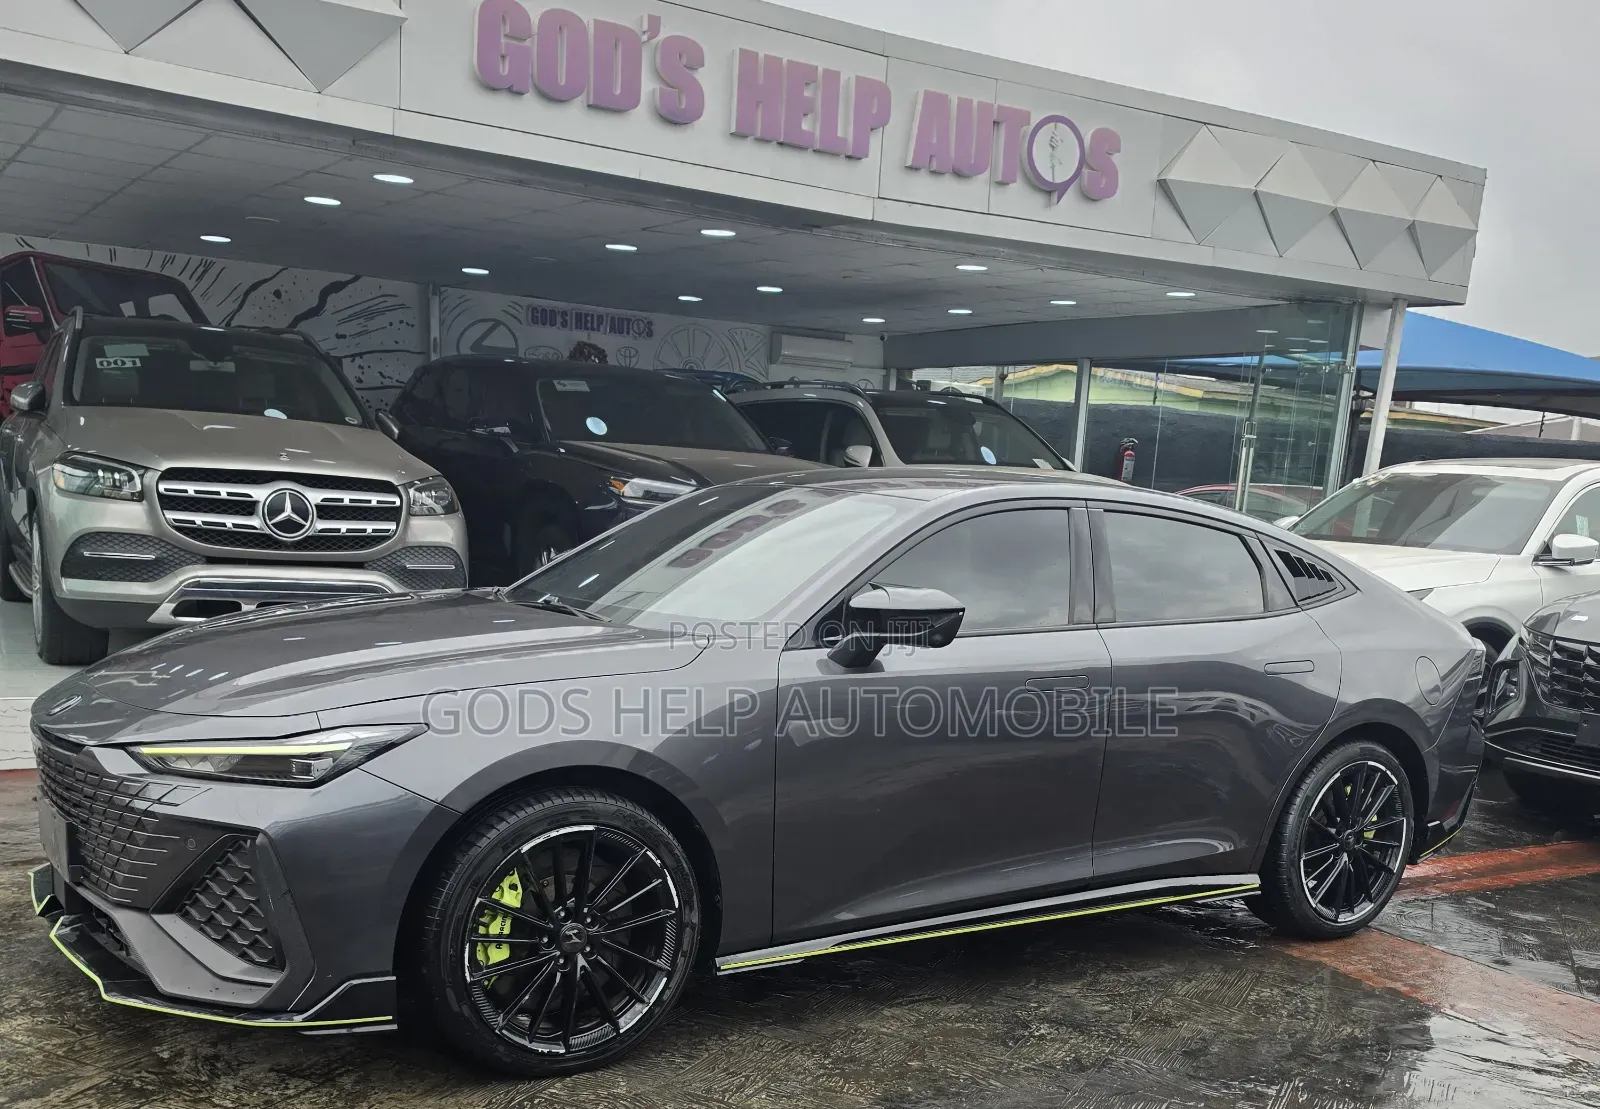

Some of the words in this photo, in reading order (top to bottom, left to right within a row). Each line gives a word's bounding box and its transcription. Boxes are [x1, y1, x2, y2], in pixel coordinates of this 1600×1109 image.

[473, 0, 705, 125] GOD'S
[730, 48, 891, 160] HELP
[905, 89, 1121, 204] AUTOS
[530, 306, 569, 329] GOD'S
[574, 311, 605, 332] HELP
[609, 315, 654, 338] AUTOS
